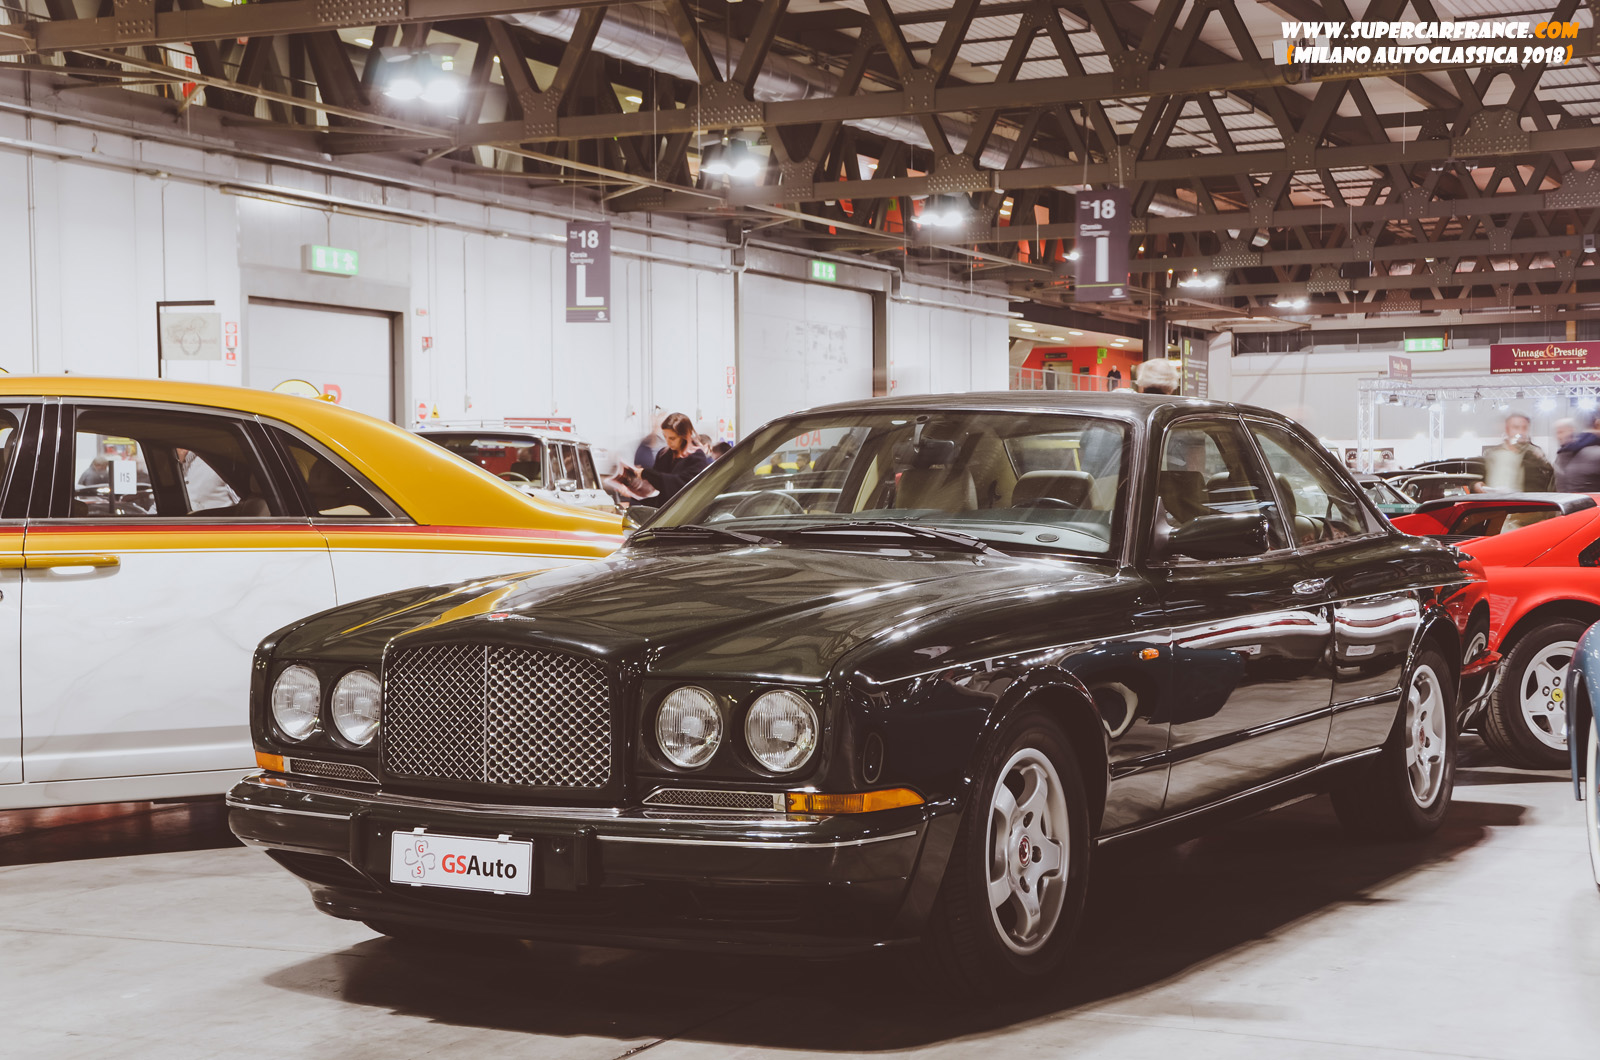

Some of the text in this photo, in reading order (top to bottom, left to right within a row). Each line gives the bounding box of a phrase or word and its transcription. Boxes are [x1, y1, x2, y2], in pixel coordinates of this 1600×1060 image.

[1090, 199, 1116, 219] 18
[578, 230, 599, 248] 18
[576, 264, 605, 306] L
[1511, 348, 1544, 358] Vintage
[1553, 347, 1588, 357] Prestige
[441, 854, 517, 879] GSAuto
